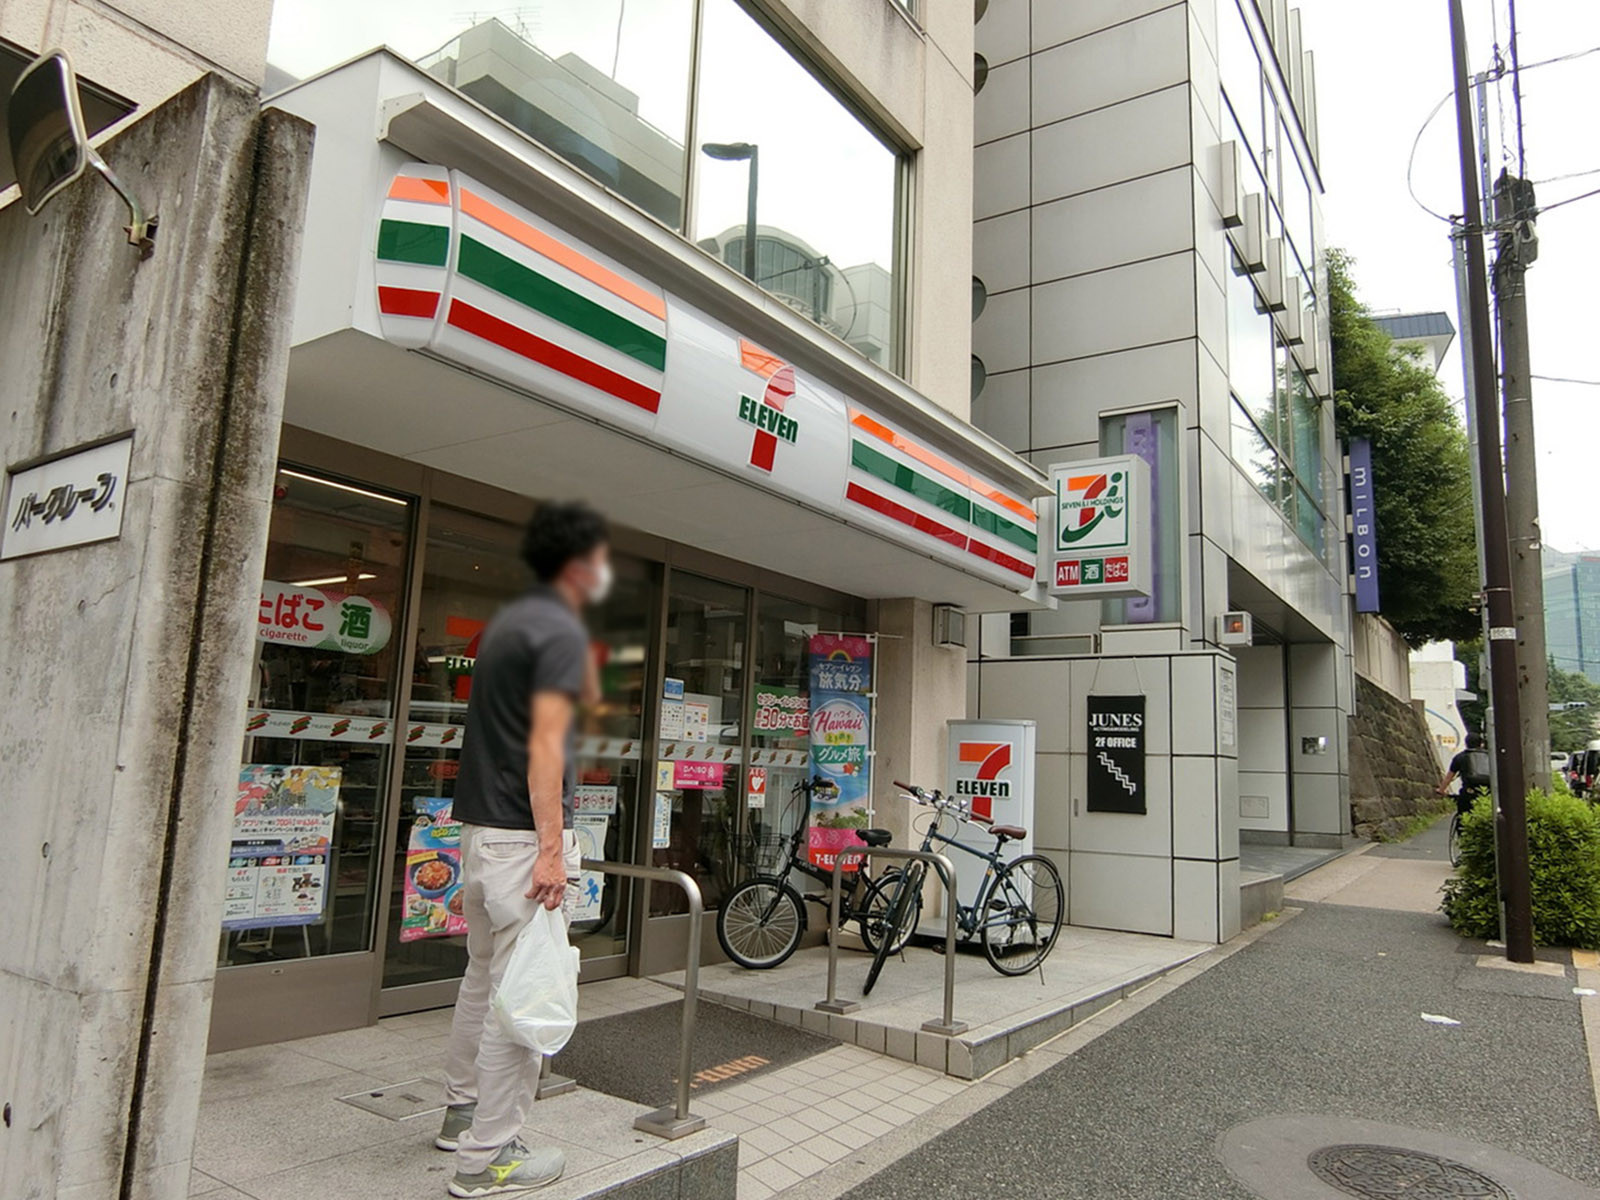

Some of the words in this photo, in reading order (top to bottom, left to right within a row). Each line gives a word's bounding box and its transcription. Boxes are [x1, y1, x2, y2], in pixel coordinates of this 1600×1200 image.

[1090, 497, 1124, 507] HOLDINGS
[1058, 566, 1079, 581] ATM
[1085, 564, 1100, 580] 酒
[1105, 562, 1129, 578] たばこ
[339, 602, 372, 639] 酒
[259, 628, 309, 643] cigarette
[341, 638, 370, 650] liquor
[818, 673, 862, 691] 旅気分
[814, 709, 865, 732] Hawaii
[1089, 713, 1143, 727] JUNES
[1095, 736, 1106, 748] 2F
[1107, 736, 1137, 748] OFFICE
[818, 747, 862, 762] グルメ旅
